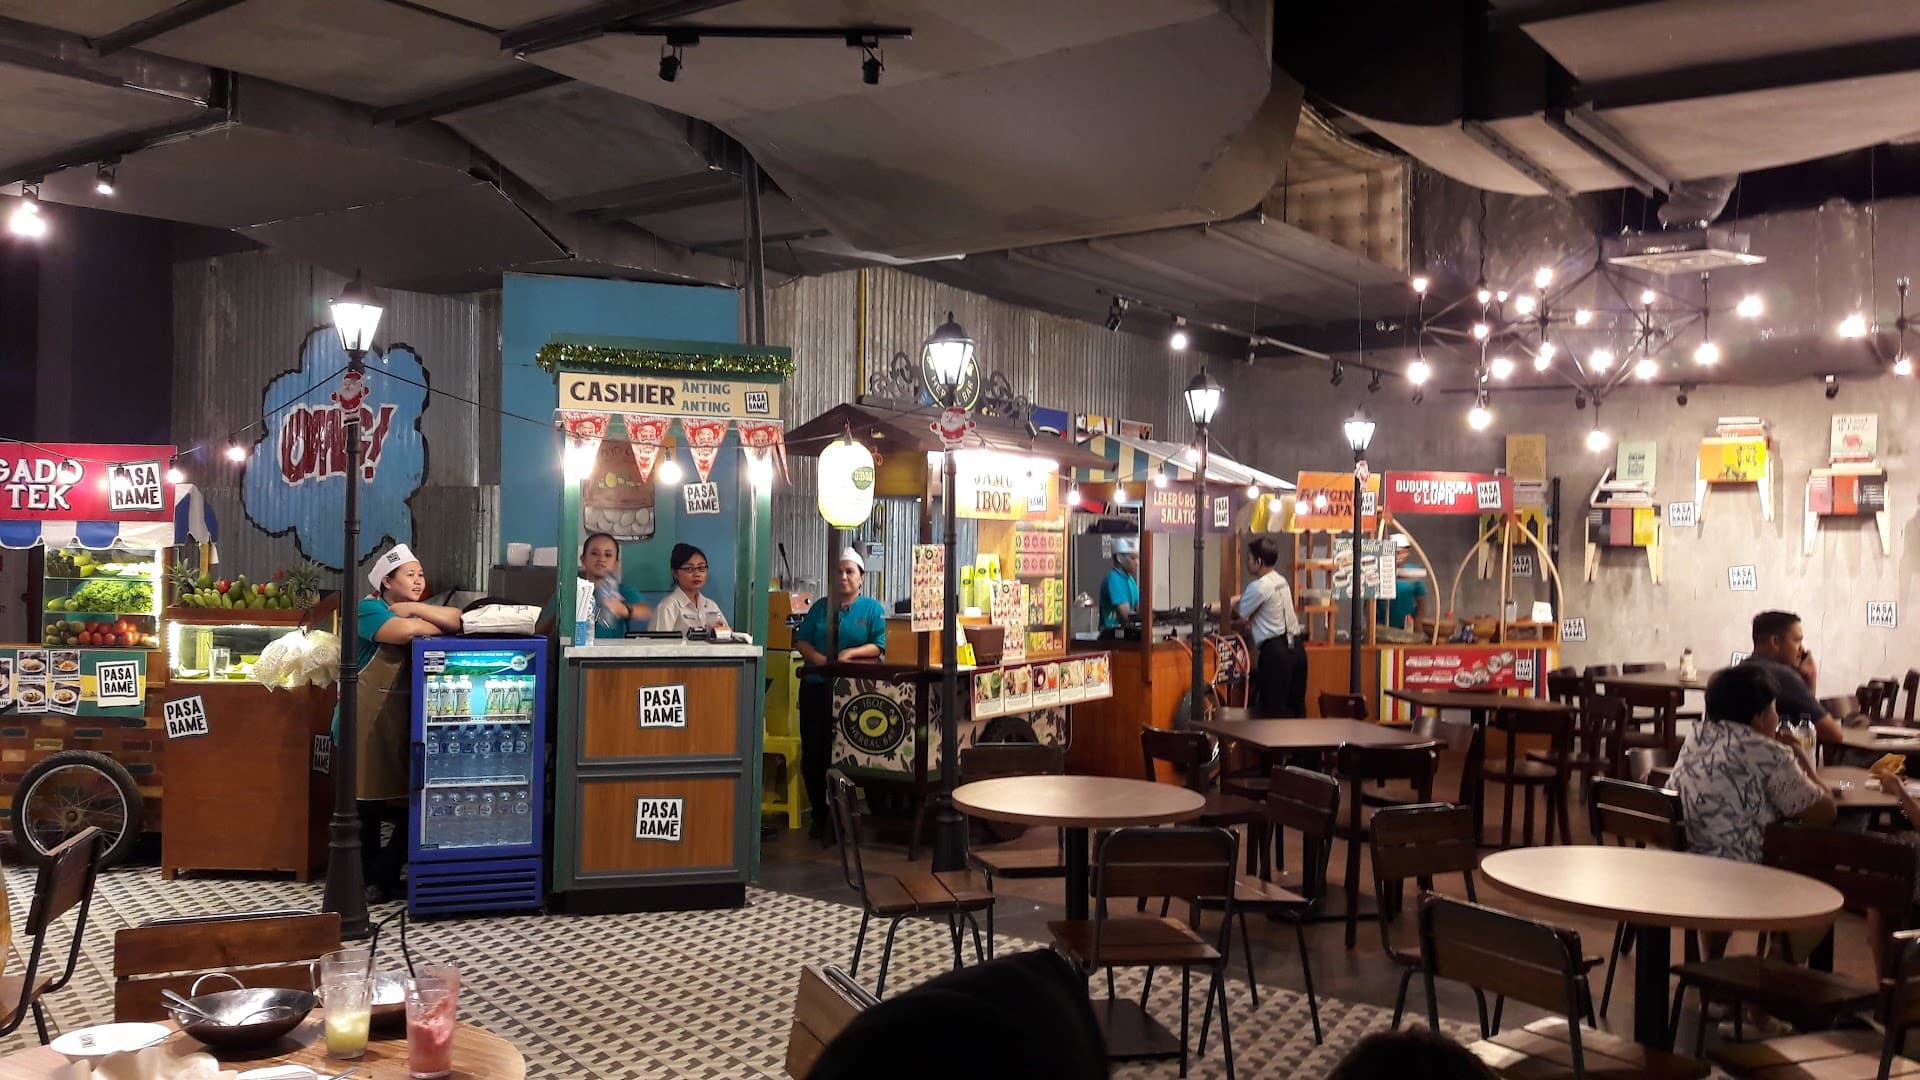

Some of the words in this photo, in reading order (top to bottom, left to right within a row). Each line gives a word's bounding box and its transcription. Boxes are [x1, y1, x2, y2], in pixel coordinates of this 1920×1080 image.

[570, 381, 676, 406] CASHIER
[681, 382, 731, 395] ANTING
[681, 400, 731, 413] ANTING
[686, 484, 717, 499] PASA
[1154, 491, 1178, 507] LEKER
[975, 490, 1012, 514] IBOE
[1671, 505, 1692, 514] PASA
[1731, 568, 1752, 577] PASA
[1870, 605, 1893, 615] PASA
[104, 667, 133, 682] PASA
[643, 688, 682, 707] PASA
[862, 698, 886, 711] IBOE
[166, 699, 202, 721] PASA
[641, 801, 679, 819] PASA
